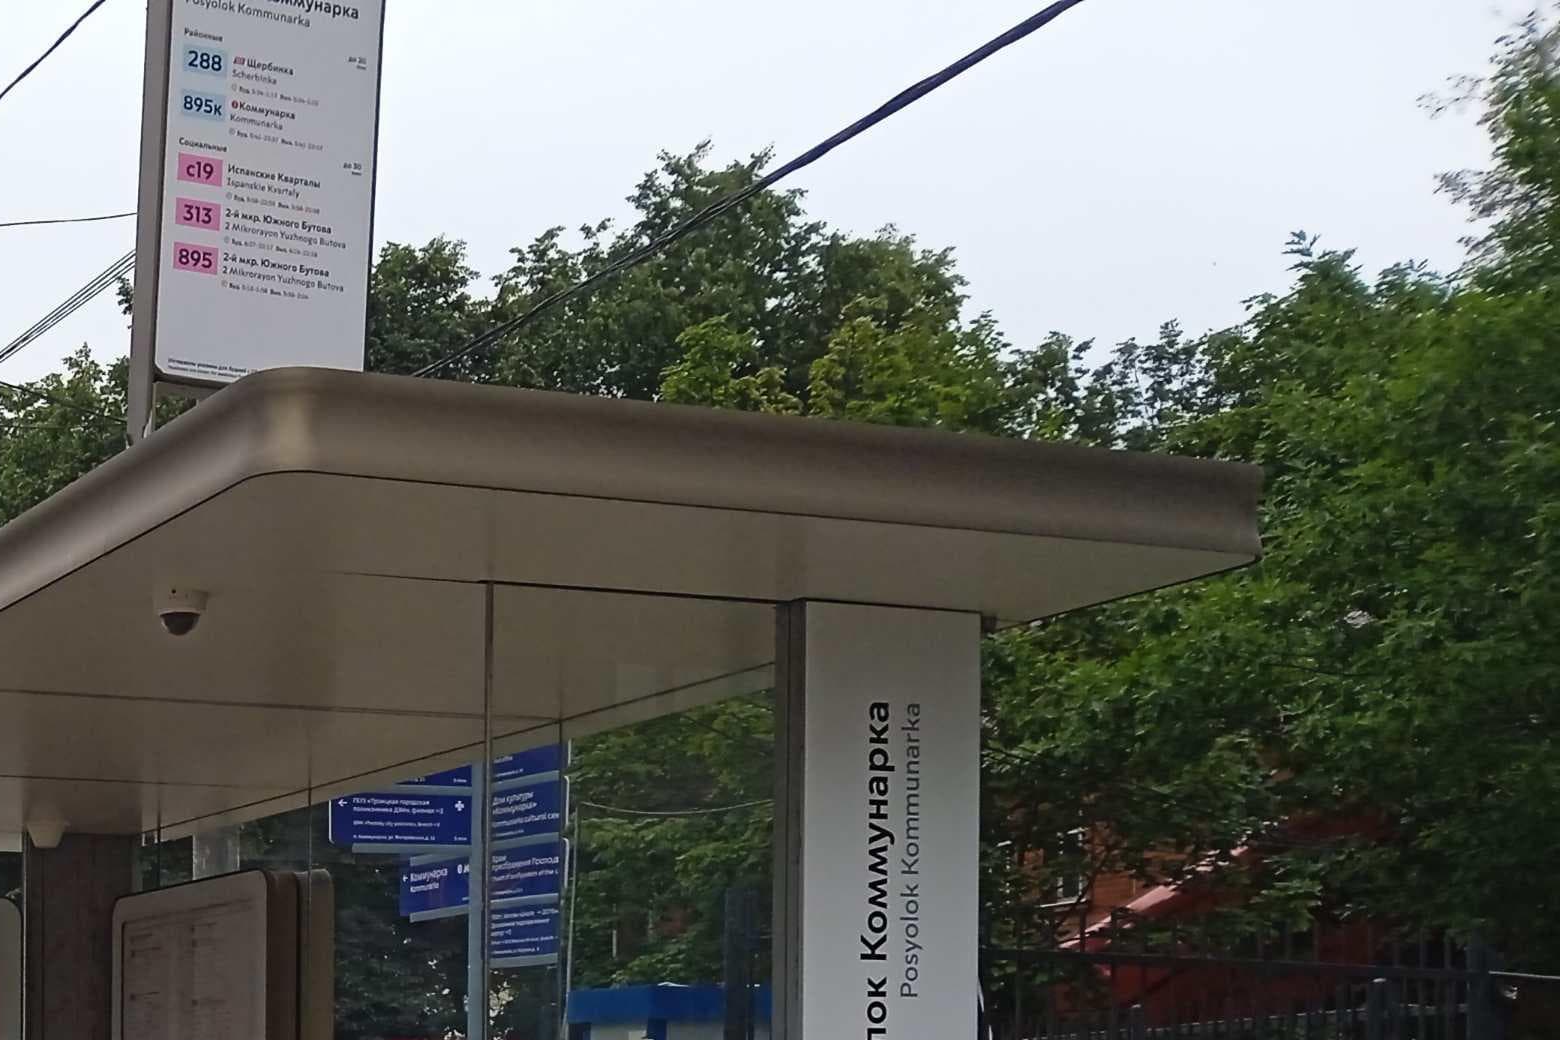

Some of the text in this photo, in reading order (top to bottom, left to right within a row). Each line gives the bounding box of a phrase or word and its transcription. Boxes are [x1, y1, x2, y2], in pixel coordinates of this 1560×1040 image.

[185, 0, 310, 28] osyolok Kommunarka
[266, 0, 359, 20] мунарка
[188, 50, 222, 71] 288
[247, 58, 294, 76] Щербинка
[230, 114, 283, 130] Kommunarka
[240, 101, 296, 119] Коммунарка
[228, 164, 320, 188] Испанские Кварталы
[183, 204, 212, 225] 313
[226, 208, 239, 218] 2-й
[263, 215, 300, 229] Южного
[301, 221, 332, 234] Бутова
[224, 222, 230, 231] 2
[232, 223, 279, 238] Mikrorayon
[280, 231, 318, 246] Yuzhnogo
[319, 237, 346, 249] Butova
[179, 248, 212, 268] 895
[223, 252, 237, 262] 2-й
[261, 258, 297, 272] Южного
[299, 264, 330, 277] Бутова
[222, 266, 228, 274] 2
[229, 267, 276, 281] Mikrorayon
[277, 274, 316, 289] Yuzhnogo
[317, 280, 344, 292] Butova
[860, 699, 895, 961] Коммунарка
[900, 701, 922, 998] Posyolok Kommunarka
